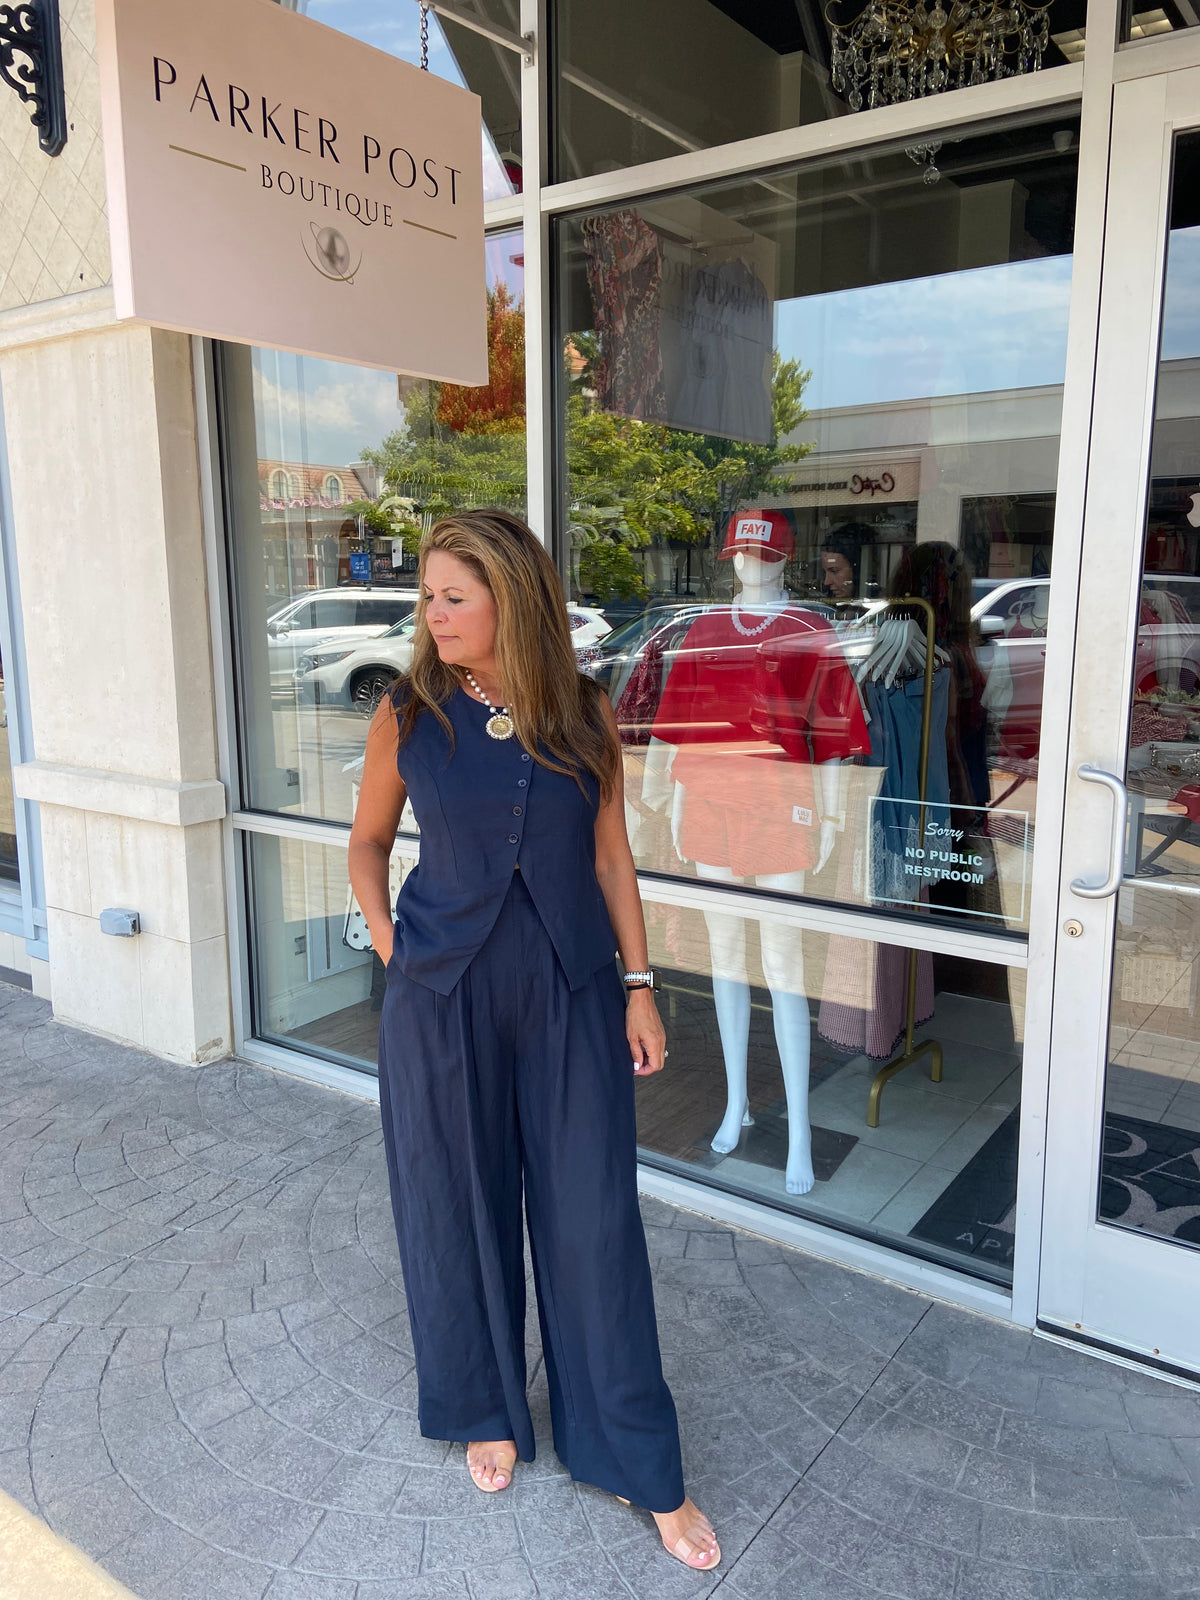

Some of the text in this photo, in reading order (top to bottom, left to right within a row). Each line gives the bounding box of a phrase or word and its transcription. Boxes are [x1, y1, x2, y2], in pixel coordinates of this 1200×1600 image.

[153, 56, 461, 204] PARKER POST
[260, 164, 393, 227] BOUTIQUE
[741, 523, 766, 536] FAY!
[924, 822, 965, 842] Sorry
[905, 847, 983, 866] NO PUBLIC
[904, 864, 984, 885] RESTROOM
